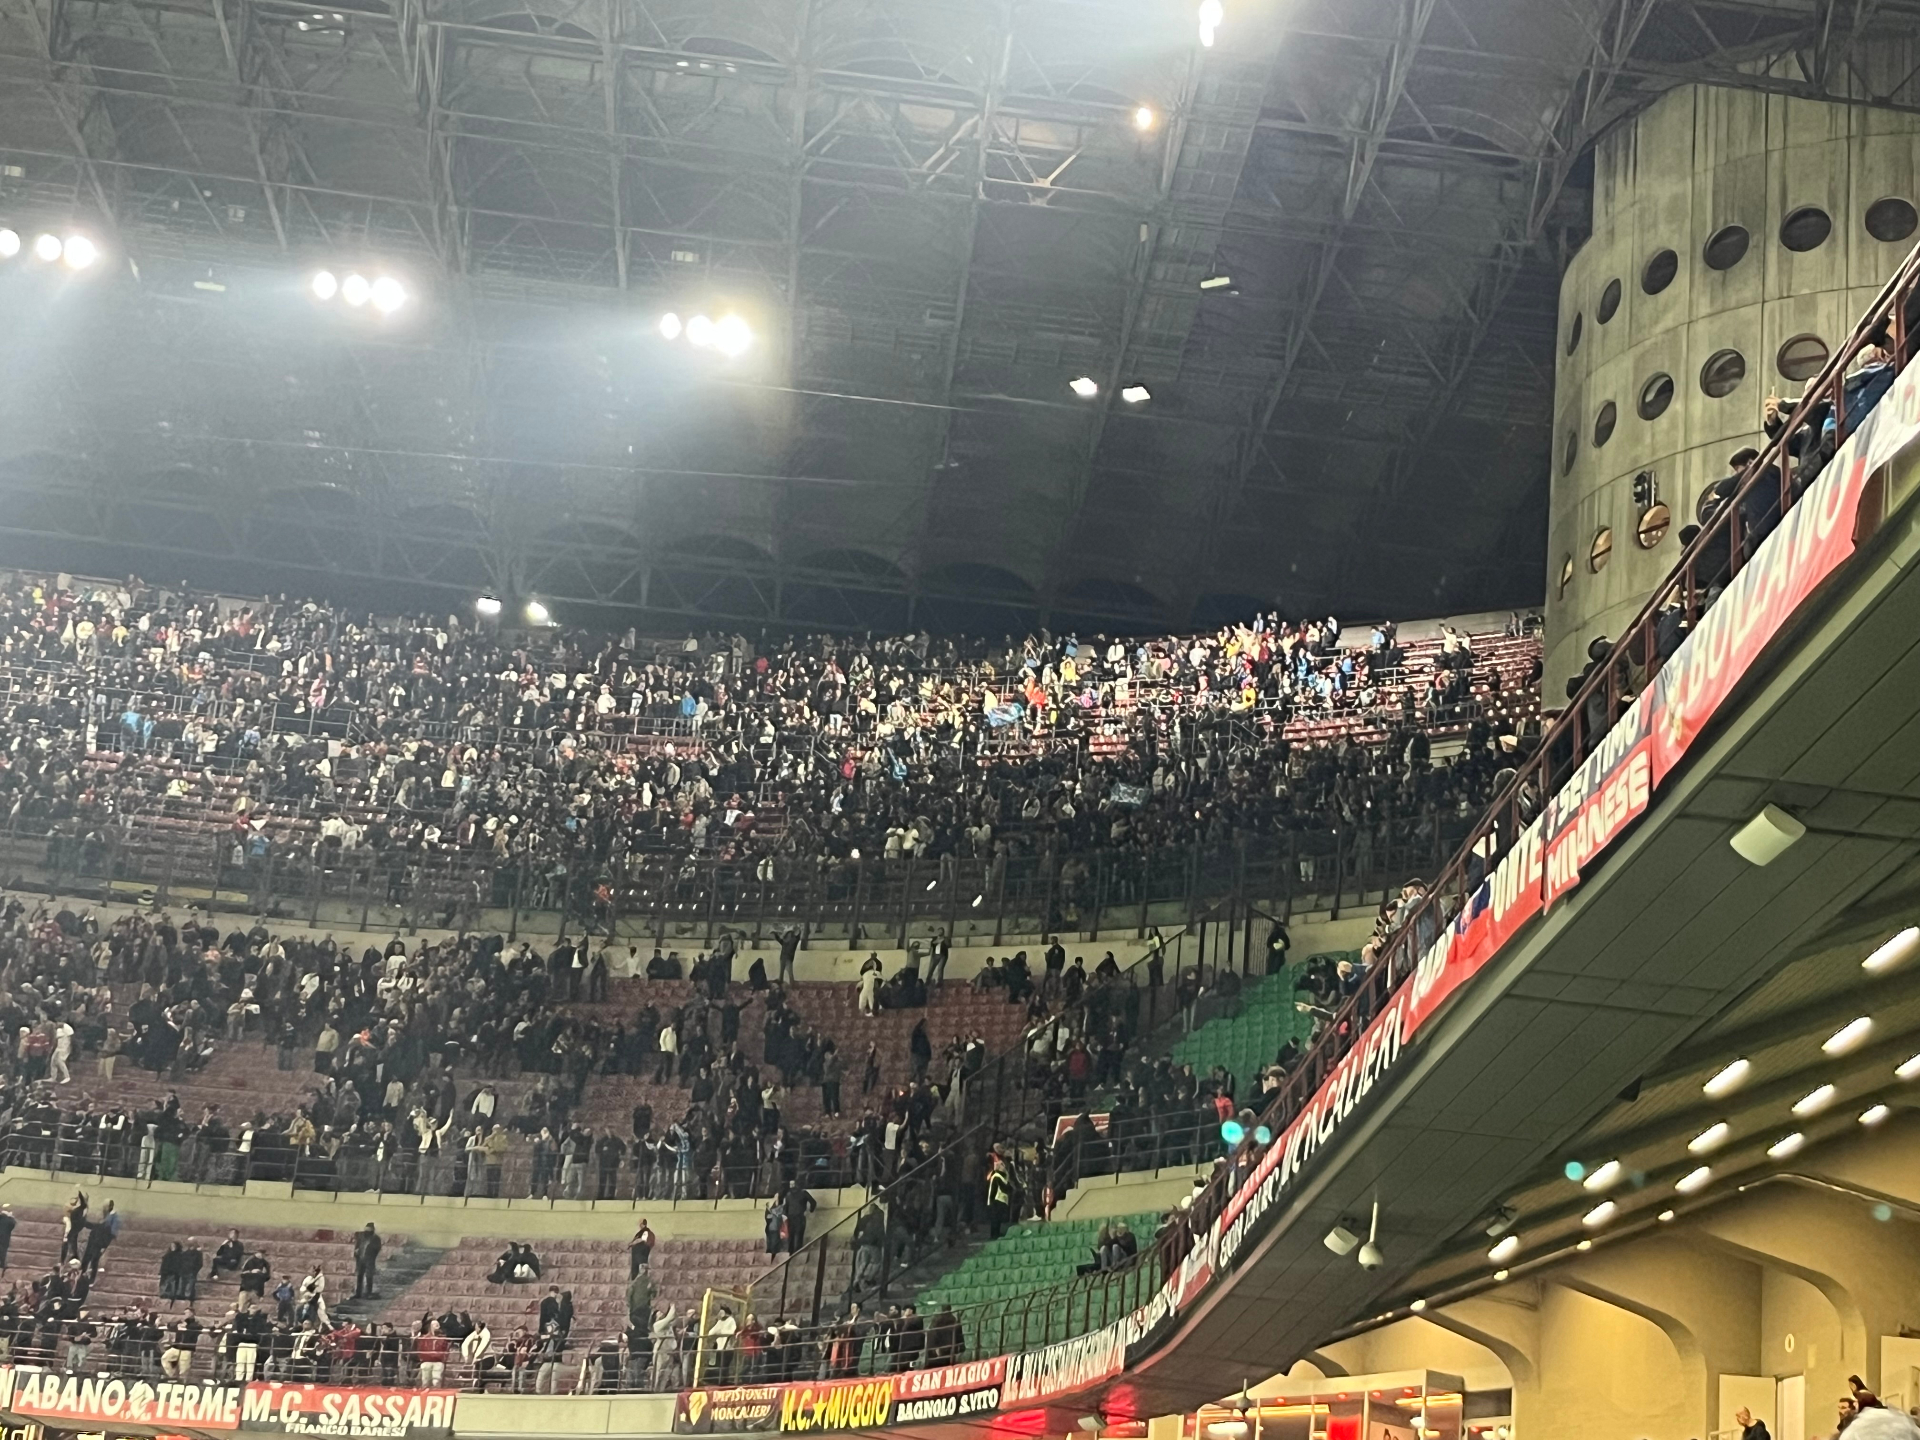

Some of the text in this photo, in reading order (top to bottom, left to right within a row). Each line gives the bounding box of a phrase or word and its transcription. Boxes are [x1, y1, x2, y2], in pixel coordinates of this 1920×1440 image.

[1689, 434, 1857, 701] BOLZANO
[1557, 697, 1641, 827] SETTIMO
[1546, 751, 1649, 901] MILANESE
[911, 1361, 990, 1393] SAN BIAGIO
[18, 1373, 241, 1423] ABANO TERME
[241, 1388, 455, 1428] M.C. SASSARI
[710, 1404, 771, 1421] MONCALIERI
[896, 1396, 956, 1422] BAGNOLO
[285, 1422, 406, 1437] FRANCO BARESI
